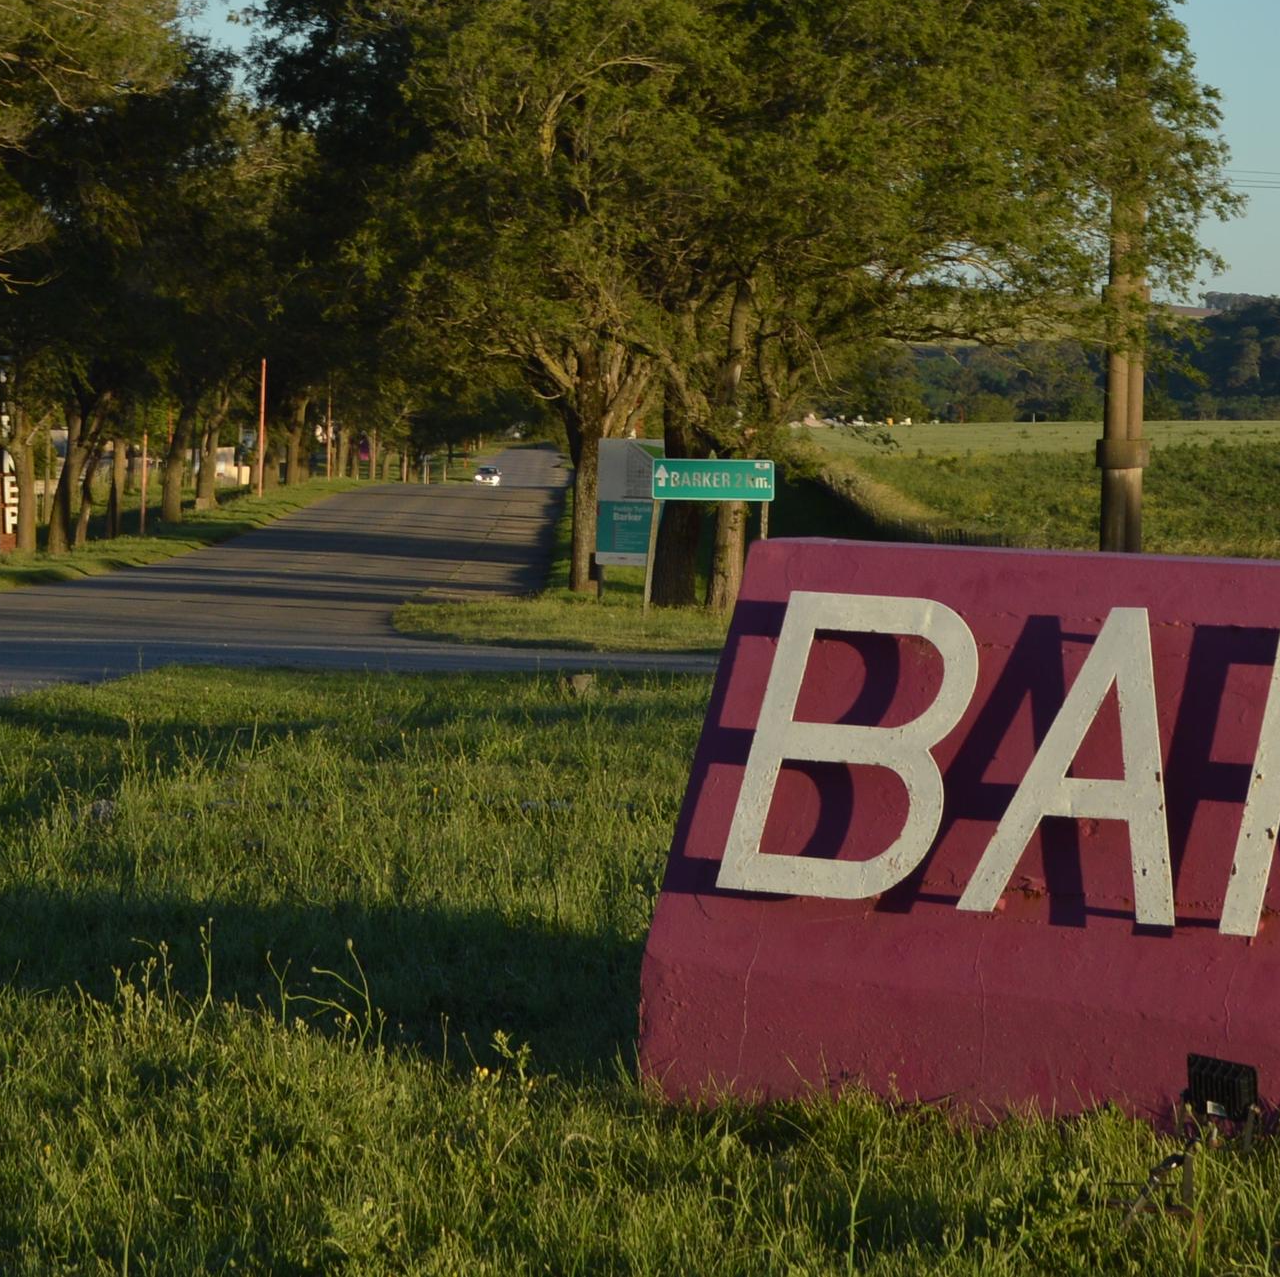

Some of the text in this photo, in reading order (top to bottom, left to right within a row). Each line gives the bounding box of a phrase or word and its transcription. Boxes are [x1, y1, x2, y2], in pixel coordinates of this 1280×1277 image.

[670, 471, 731, 488] BARKER
[735, 472, 743, 488] 2
[613, 511, 642, 522] Barker
